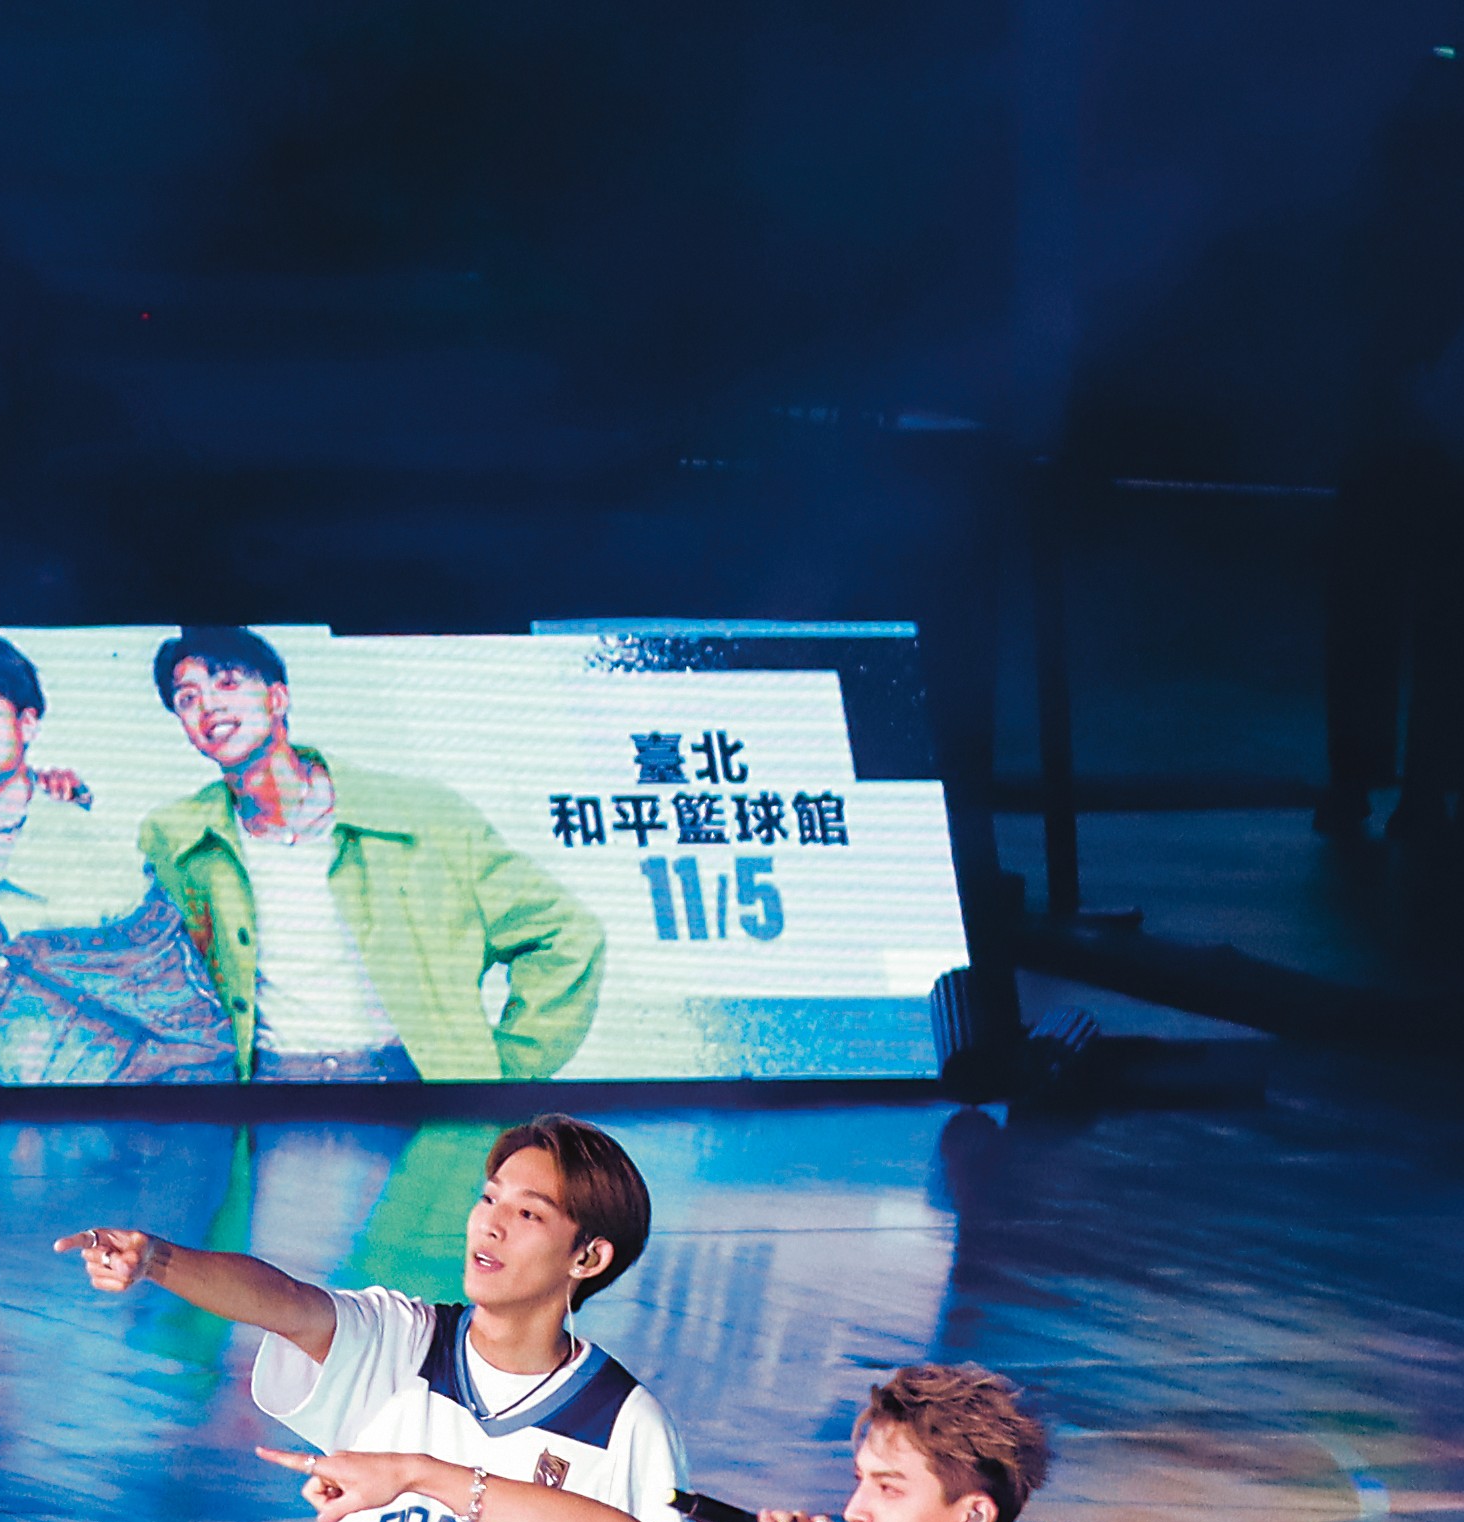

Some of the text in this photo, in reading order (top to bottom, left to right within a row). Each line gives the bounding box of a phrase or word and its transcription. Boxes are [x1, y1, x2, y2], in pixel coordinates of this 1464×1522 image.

[629, 729, 749, 784] 臺北
[548, 790, 850, 847] 和平籃球館
[639, 856, 785, 941] 11/5
